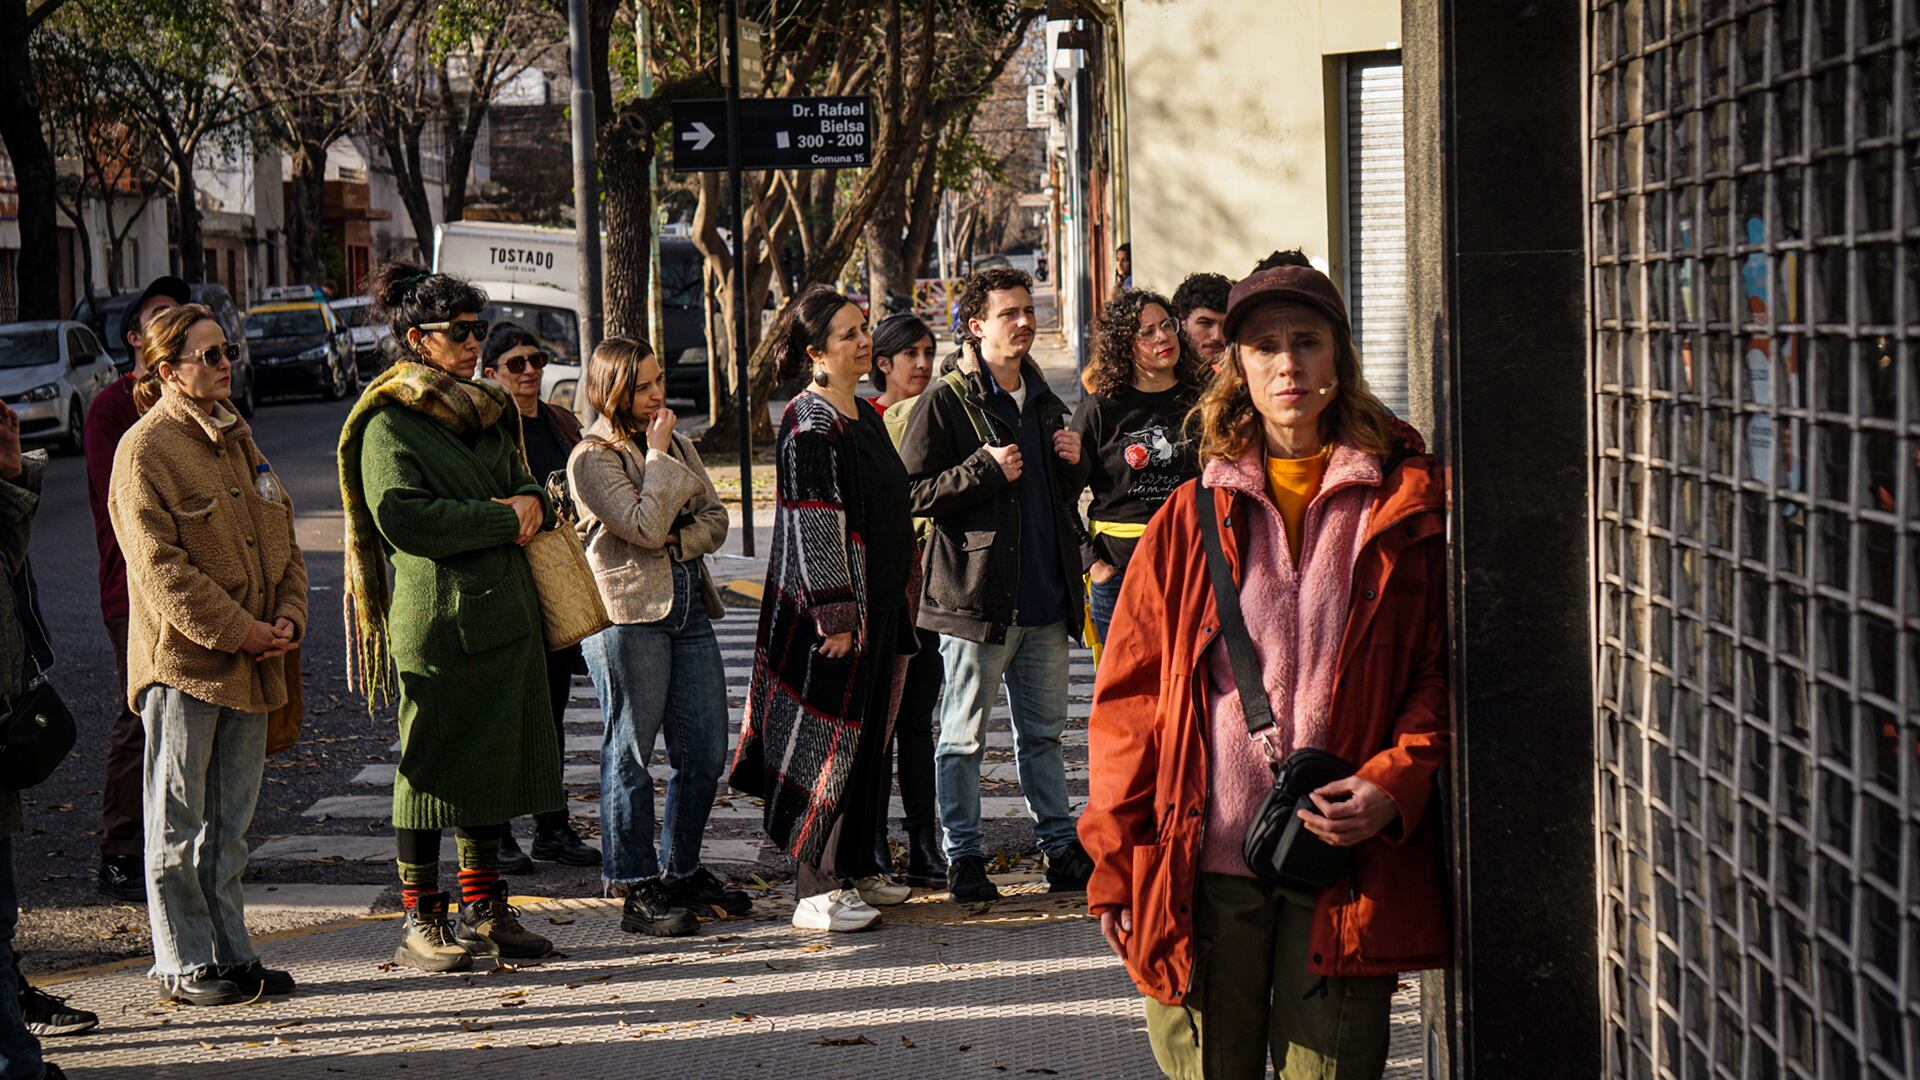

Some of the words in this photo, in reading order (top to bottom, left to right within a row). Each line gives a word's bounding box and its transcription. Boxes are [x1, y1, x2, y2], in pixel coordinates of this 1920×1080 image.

[793, 104, 814, 117] Dr.
[818, 102, 864, 116] Rafael
[820, 119, 865, 134] Bielsa
[797, 134, 824, 148] 300
[837, 133, 864, 147] 200
[811, 154, 851, 164] Comuna
[854, 153, 865, 163] 15
[490, 247, 554, 269] TOSTADO
